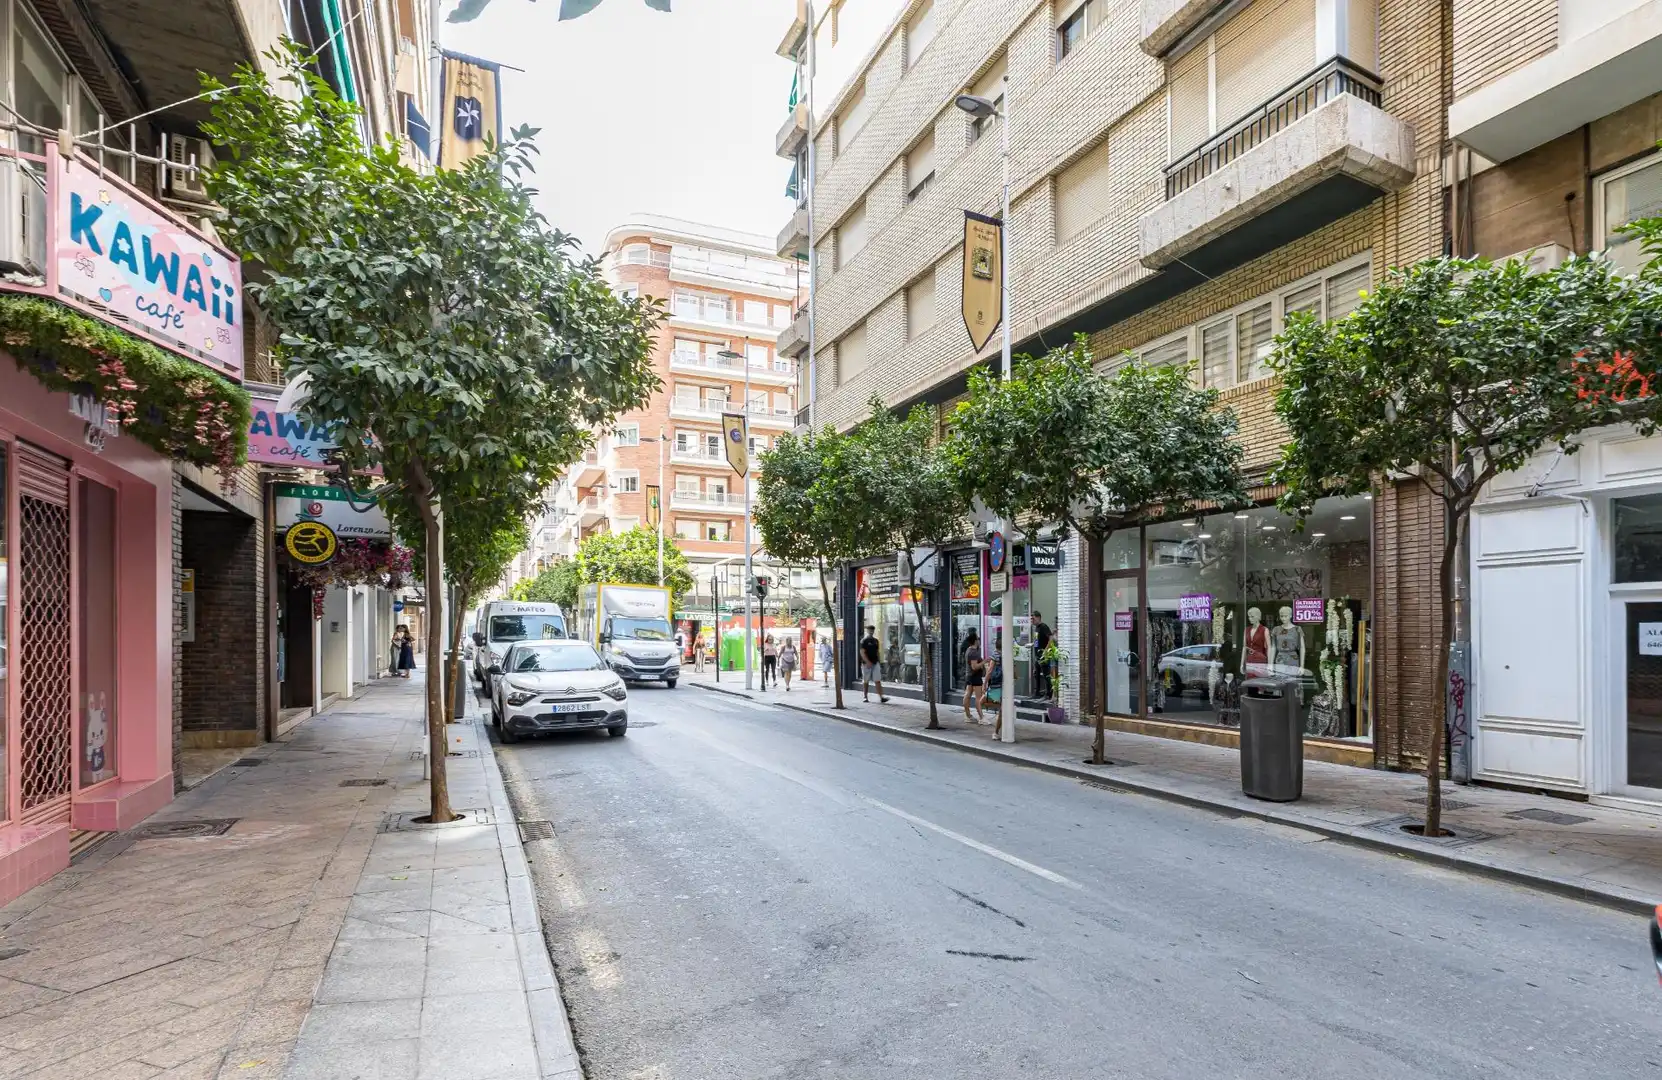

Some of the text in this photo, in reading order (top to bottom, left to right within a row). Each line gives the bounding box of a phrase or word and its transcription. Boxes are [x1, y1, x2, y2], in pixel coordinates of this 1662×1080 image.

[135, 293, 185, 330] café
[270, 444, 311, 460] café
[336, 523, 374, 534] Lorenzo
[1180, 596, 1210, 608] SEGUNDAS
[1180, 608, 1210, 620] REBAJAS
[1296, 609, 1322, 621] 50%
[557, 704, 575, 712] 2862
